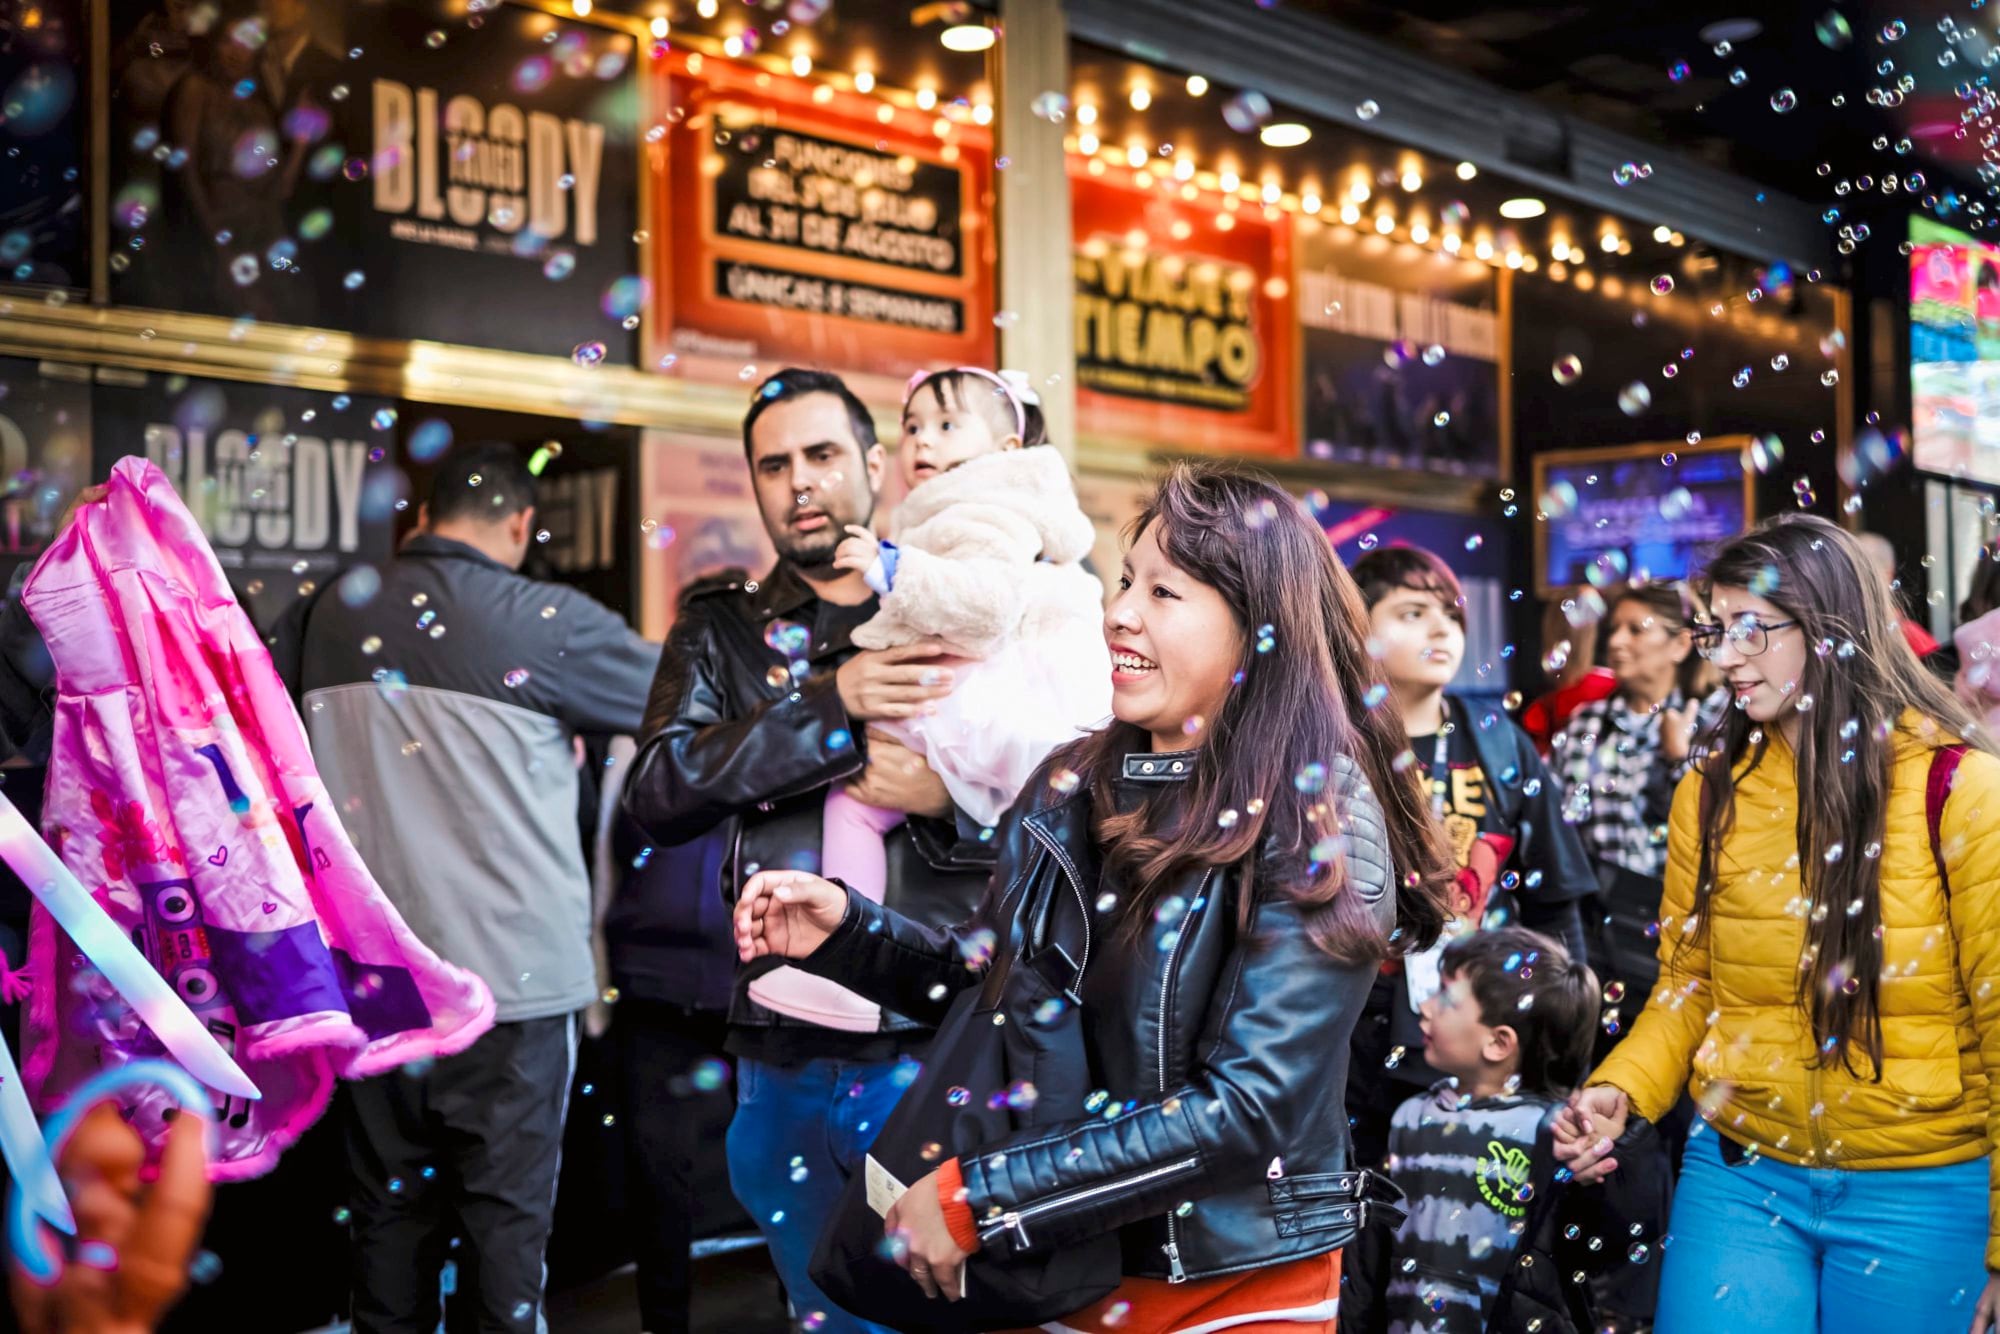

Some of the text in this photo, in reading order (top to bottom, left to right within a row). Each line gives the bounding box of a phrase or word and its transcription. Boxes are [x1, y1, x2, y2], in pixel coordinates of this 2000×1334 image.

[372, 78, 604, 245] BLOODY
[728, 203, 764, 238] AL
[802, 213, 843, 250] DE
[843, 223, 954, 271] AGOSTO
[1074, 294, 1258, 384] TIEMPO
